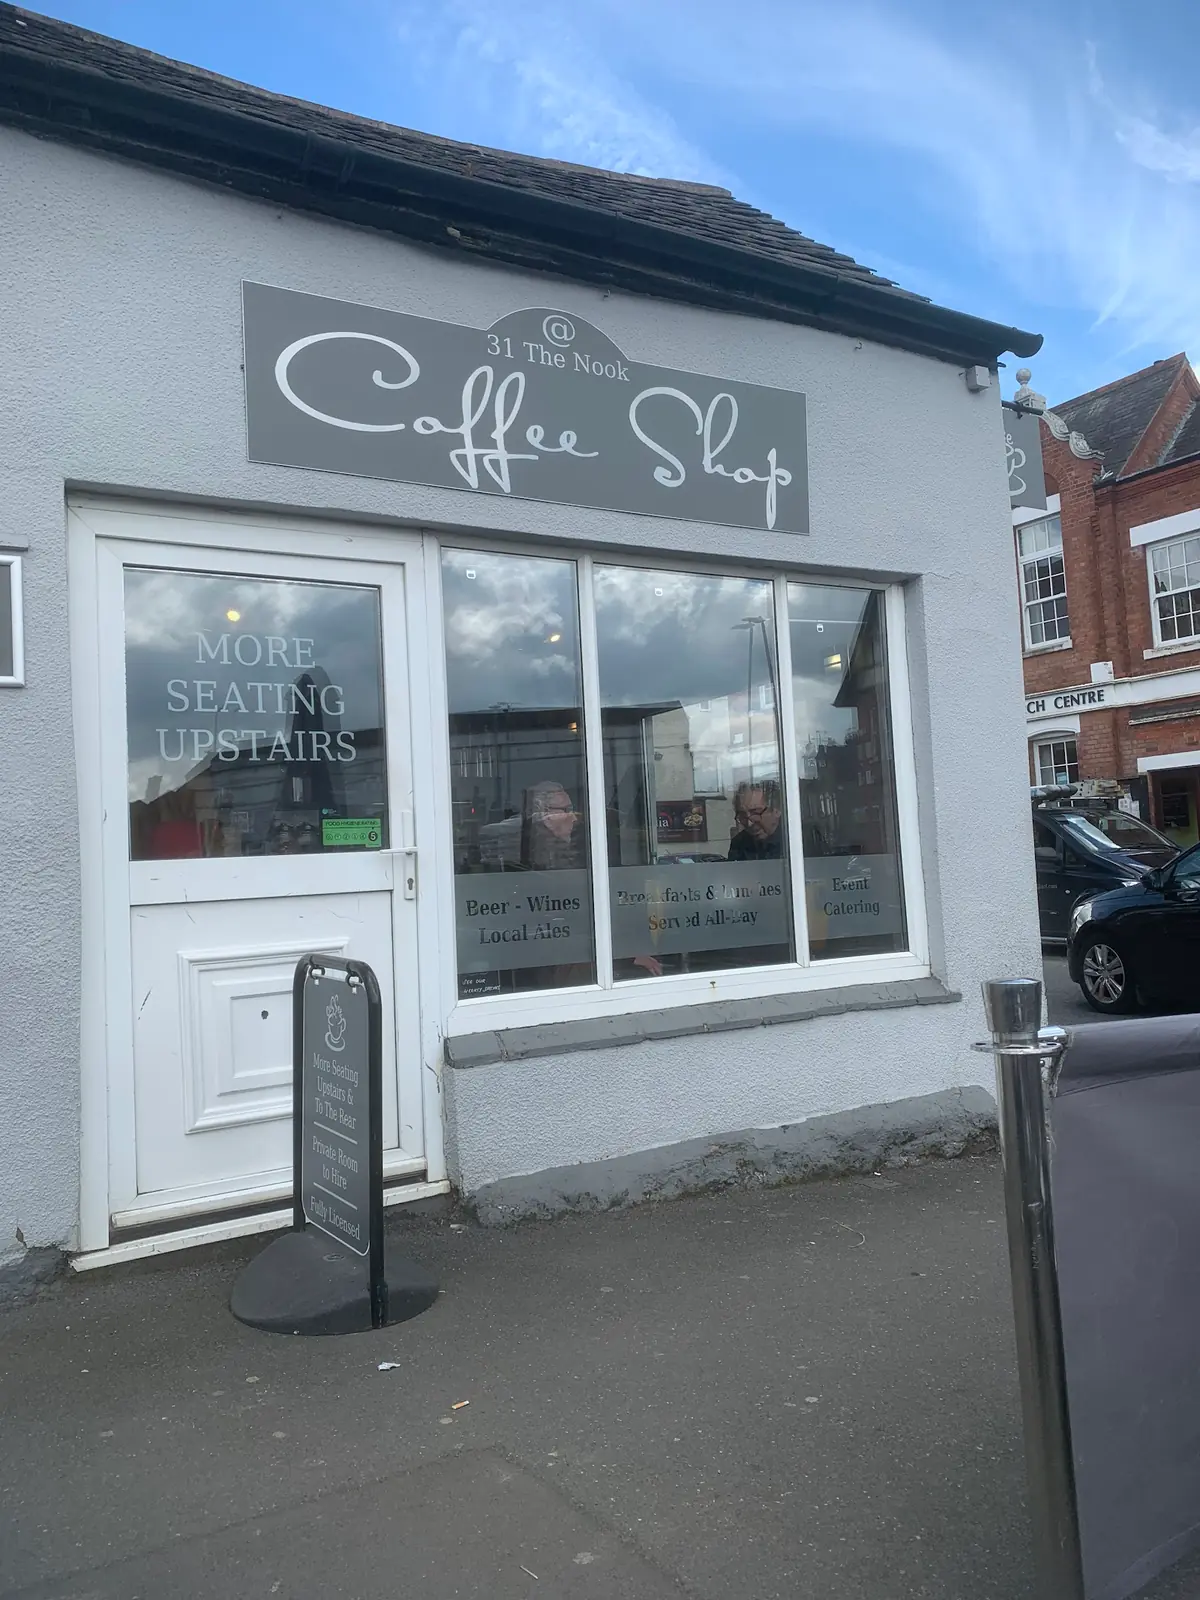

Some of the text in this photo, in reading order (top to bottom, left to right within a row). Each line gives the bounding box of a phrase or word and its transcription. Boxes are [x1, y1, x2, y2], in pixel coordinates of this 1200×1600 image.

[542, 314, 576, 348] @
[487, 334, 630, 382] 31 The Nook
[275, 331, 792, 530] Coffee Shop
[195, 631, 316, 669] MORE
[166, 679, 346, 716] SEATING
[1053, 689, 1105, 709] CENTRE
[155, 728, 357, 762] UPSTAIRS
[370, 832, 377, 841] 5
[705, 885, 718, 900] &
[721, 881, 782, 900] Lunhes
[832, 877, 869, 892] Event
[466, 899, 510, 917] Beer
[528, 895, 581, 913] Wines
[823, 900, 880, 916] Catering
[479, 922, 571, 945] Local Ales
[313, 1052, 359, 1088] More Seating
[317, 1075, 354, 1106] Upstairs &
[314, 1097, 357, 1130] To The Rear
[312, 1135, 358, 1173] Private Room
[322, 1163, 347, 1190] to Hire
[310, 1195, 360, 1241] Fully Licensed
